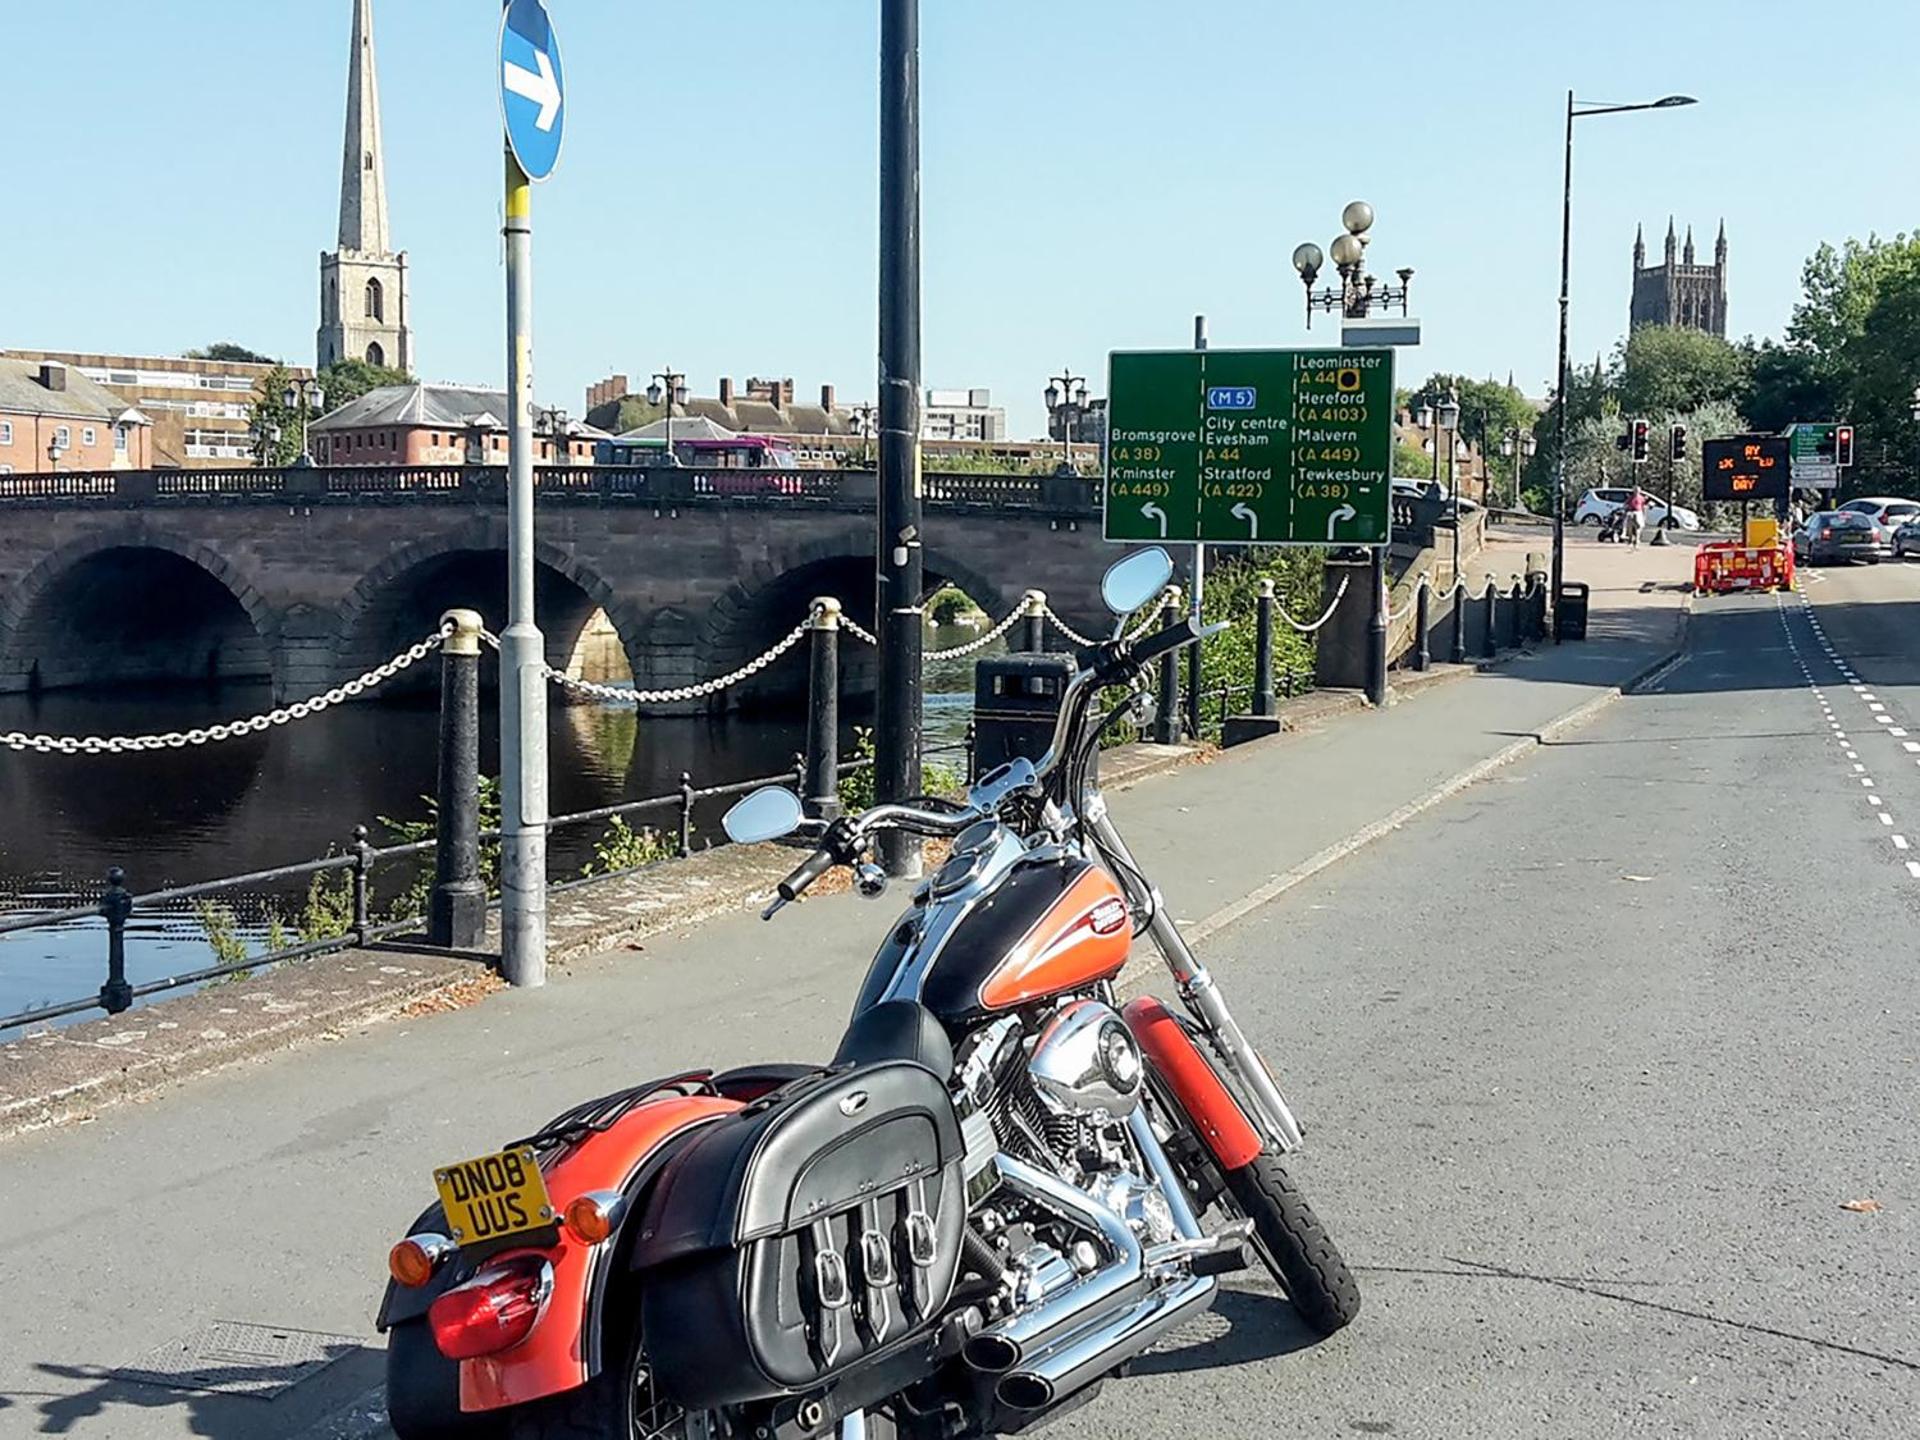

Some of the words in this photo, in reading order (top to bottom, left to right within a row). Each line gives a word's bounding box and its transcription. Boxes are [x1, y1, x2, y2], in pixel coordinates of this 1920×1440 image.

[1300, 355, 1381, 369] Leominster
[1301, 371, 1310, 384] A
[1315, 371, 1335, 384] 44
[1210, 390, 1231, 406] (M
[1236, 389, 1253, 406] 5)
[1299, 391, 1365, 405] Hereford
[1299, 407, 1318, 422] (A
[1321, 407, 1368, 422] 4103)
[1206, 416, 1235, 432] City
[1241, 417, 1287, 430] centre
[1112, 428, 1196, 444] Bromsgrove
[1206, 432, 1269, 445] Evesham
[1298, 428, 1357, 442] Malvern
[1111, 447, 1129, 461] (A
[1133, 447, 1161, 461] 38)
[1205, 448, 1216, 460] A
[1219, 448, 1240, 460] 44
[1298, 446, 1317, 462] (A
[1320, 446, 1360, 463] 449)
[1110, 466, 1176, 480] K'minster
[1204, 467, 1272, 480] Stratford
[1298, 467, 1385, 484] Tewkesbury
[1110, 481, 1128, 497] (A
[1132, 481, 1170, 497] 449)
[1203, 483, 1222, 498] (A
[1225, 483, 1263, 498] 422)
[1297, 483, 1317, 499] (A
[1320, 483, 1349, 500] 38)
[449, 1152, 526, 1202] DN08
[468, 1192, 528, 1236] UUS
